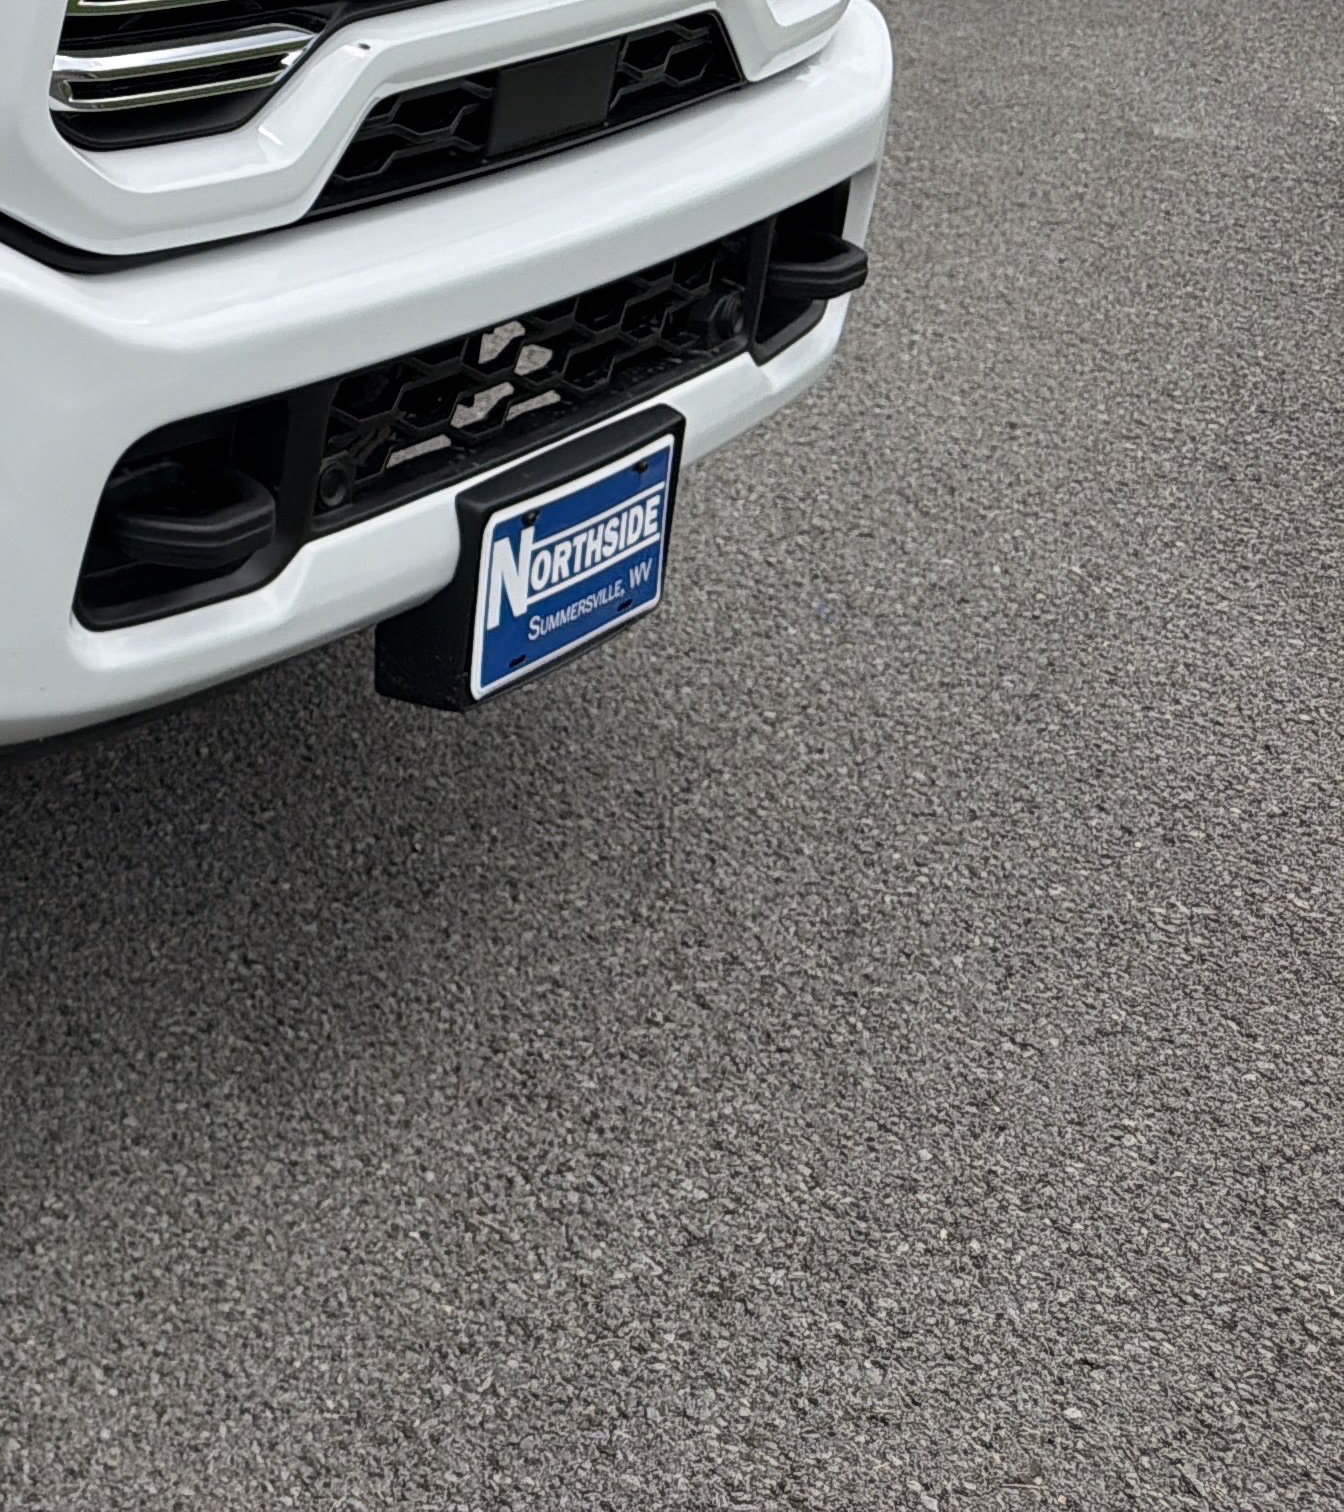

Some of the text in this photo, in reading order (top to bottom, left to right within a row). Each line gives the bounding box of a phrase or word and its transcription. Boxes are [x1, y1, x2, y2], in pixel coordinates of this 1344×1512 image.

[487, 494, 661, 630] NORTHSIDE
[528, 558, 653, 640] SUMMERSVILLE, WV
